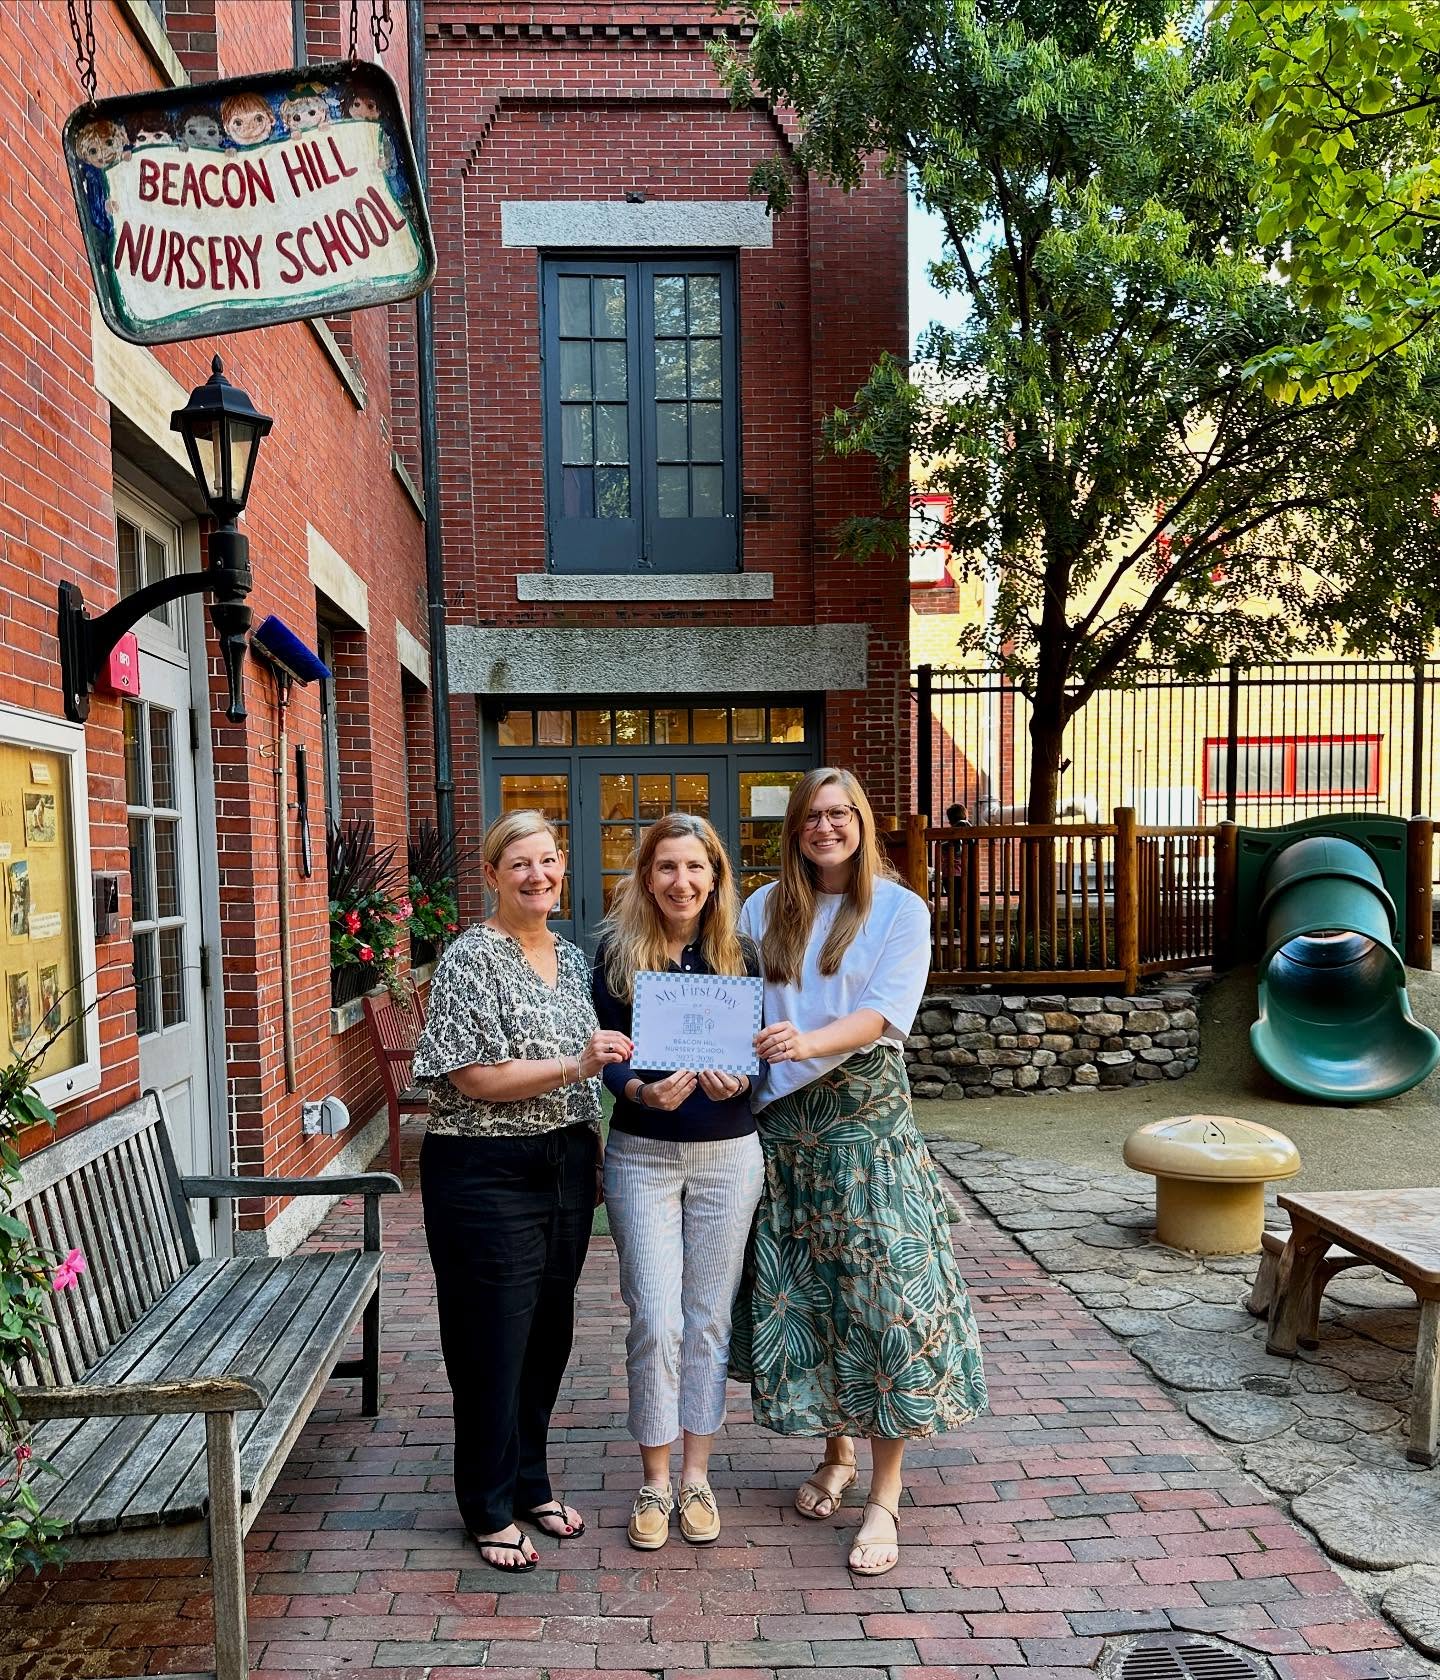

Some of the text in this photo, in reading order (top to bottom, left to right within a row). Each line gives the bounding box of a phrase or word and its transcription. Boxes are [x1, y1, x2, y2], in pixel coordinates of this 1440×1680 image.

[138, 136, 359, 209] BEACON HILL
[114, 185, 407, 290] NURSERY SCHOOL
[655, 983, 739, 1010] My First Day
[665, 1045, 725, 1055] NURSERY SCHOOL
